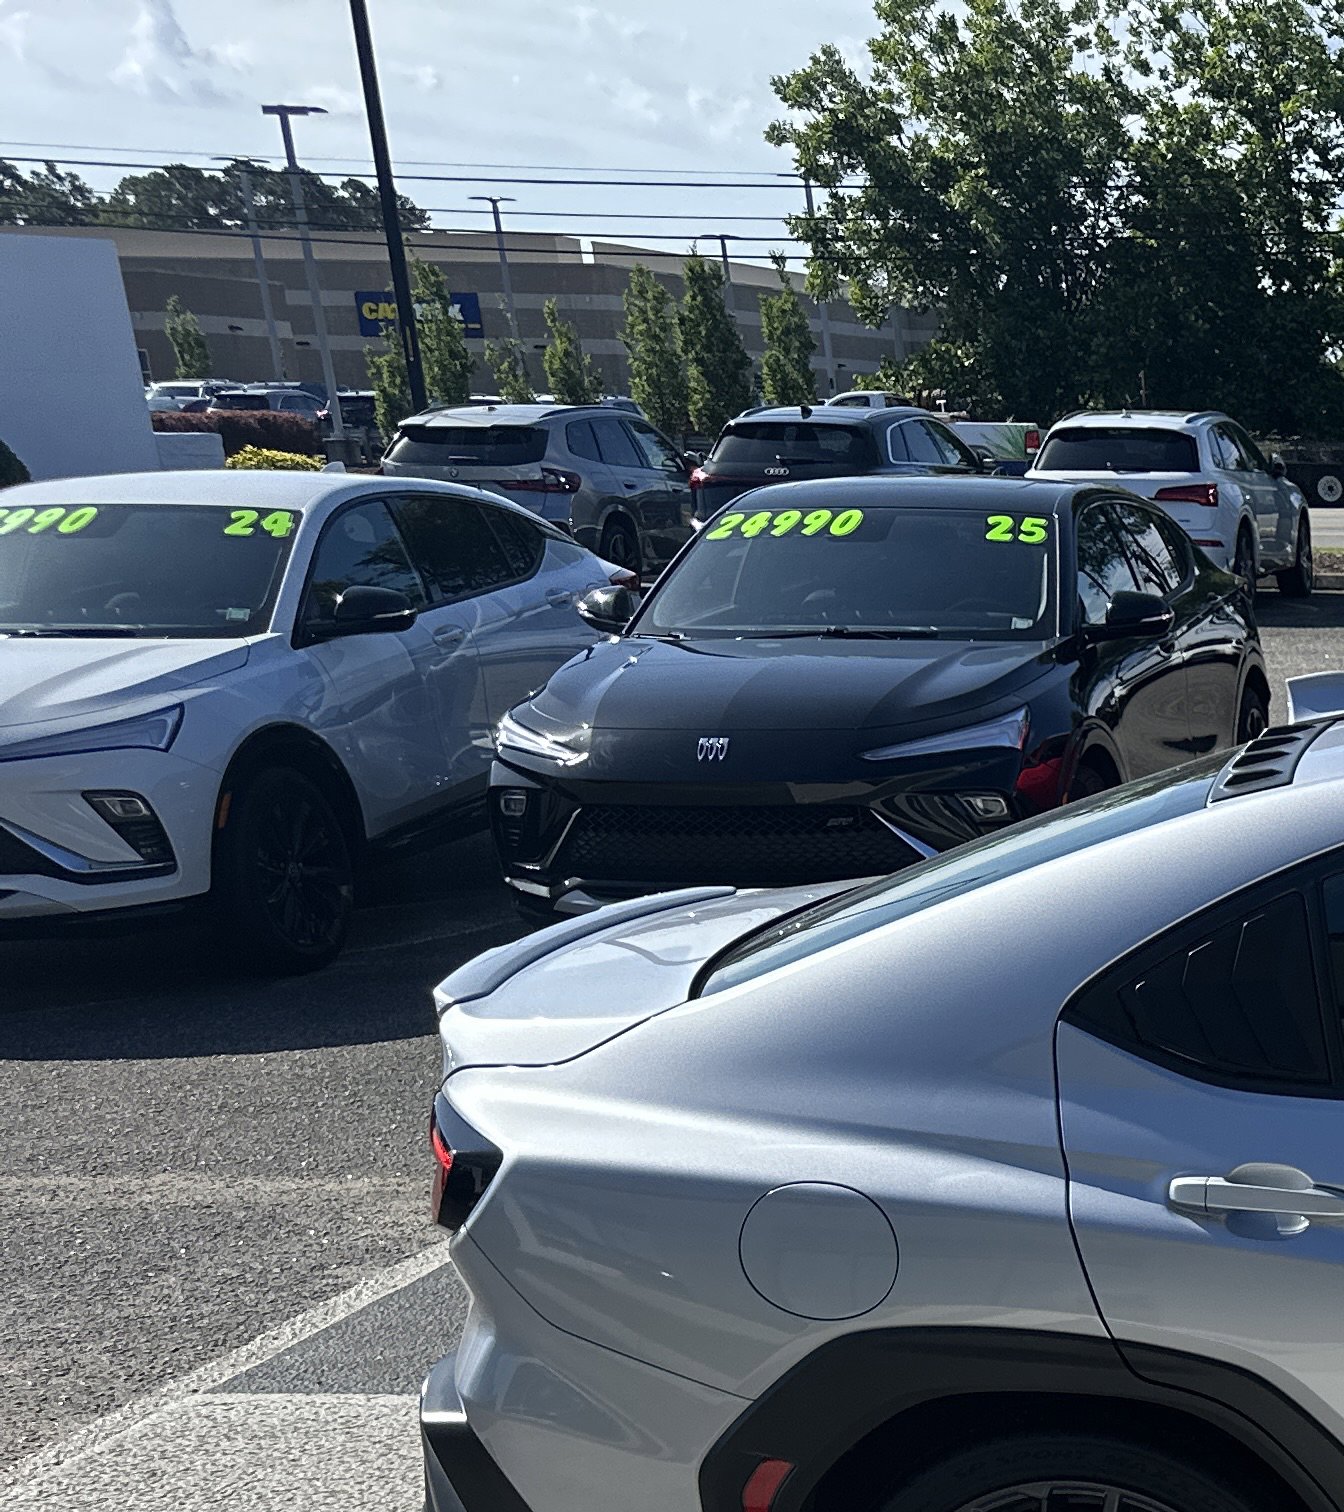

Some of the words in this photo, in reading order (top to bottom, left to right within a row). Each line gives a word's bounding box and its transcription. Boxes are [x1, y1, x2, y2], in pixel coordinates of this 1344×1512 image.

[0, 507, 98, 534] 990
[223, 510, 294, 538] 24
[705, 509, 864, 541] 24990
[985, 515, 1048, 544] 25
[995, 1449, 1089, 1465] SPORT
